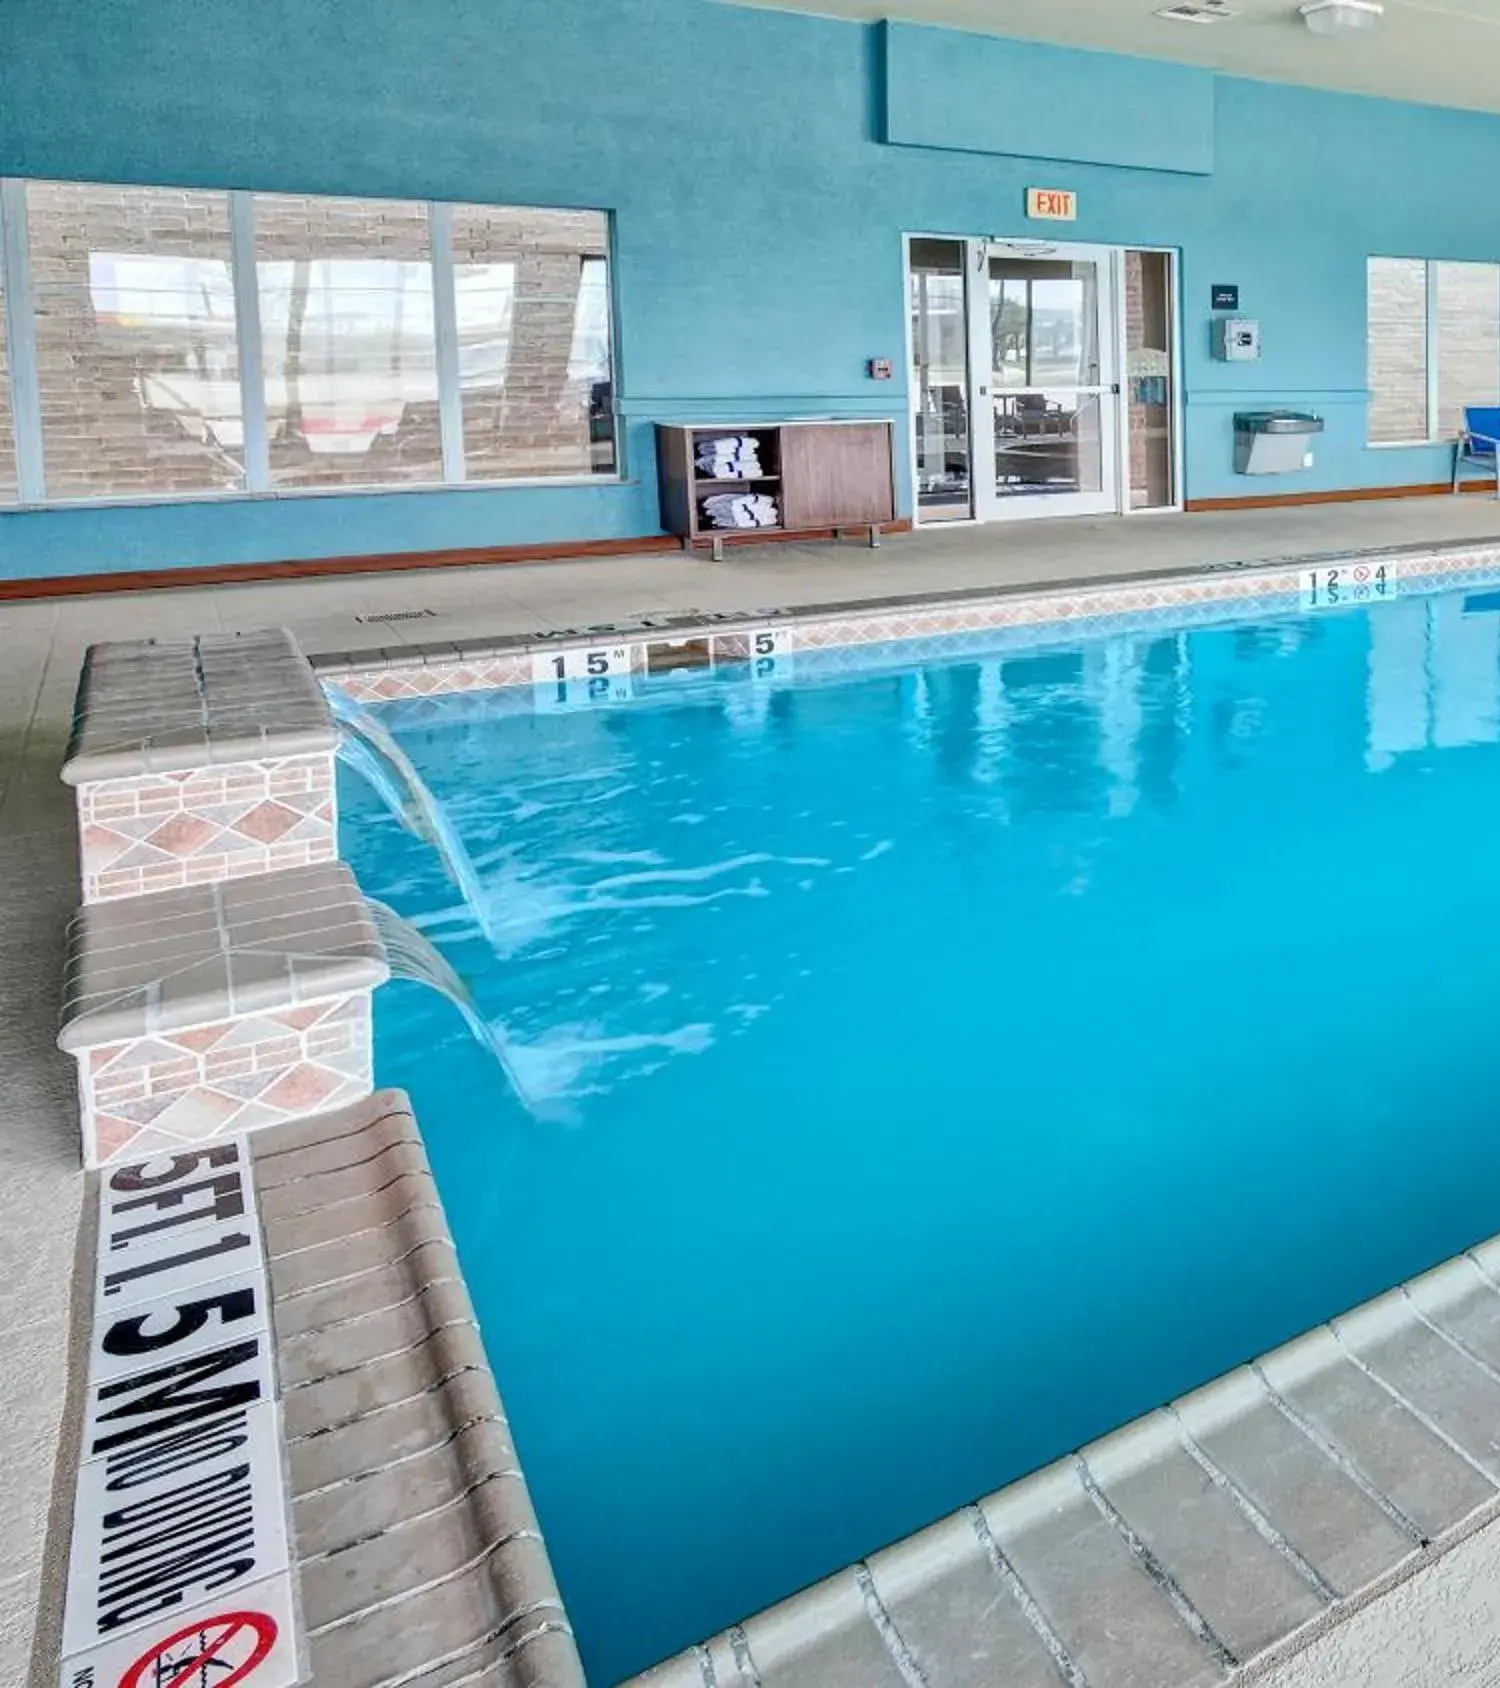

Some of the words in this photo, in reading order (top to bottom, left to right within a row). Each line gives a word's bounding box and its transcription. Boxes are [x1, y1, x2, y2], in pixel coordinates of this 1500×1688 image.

[1037, 191, 1071, 217] EXIT
[105, 1409, 248, 1491] NO
[97, 1462, 256, 1635] DIVING
